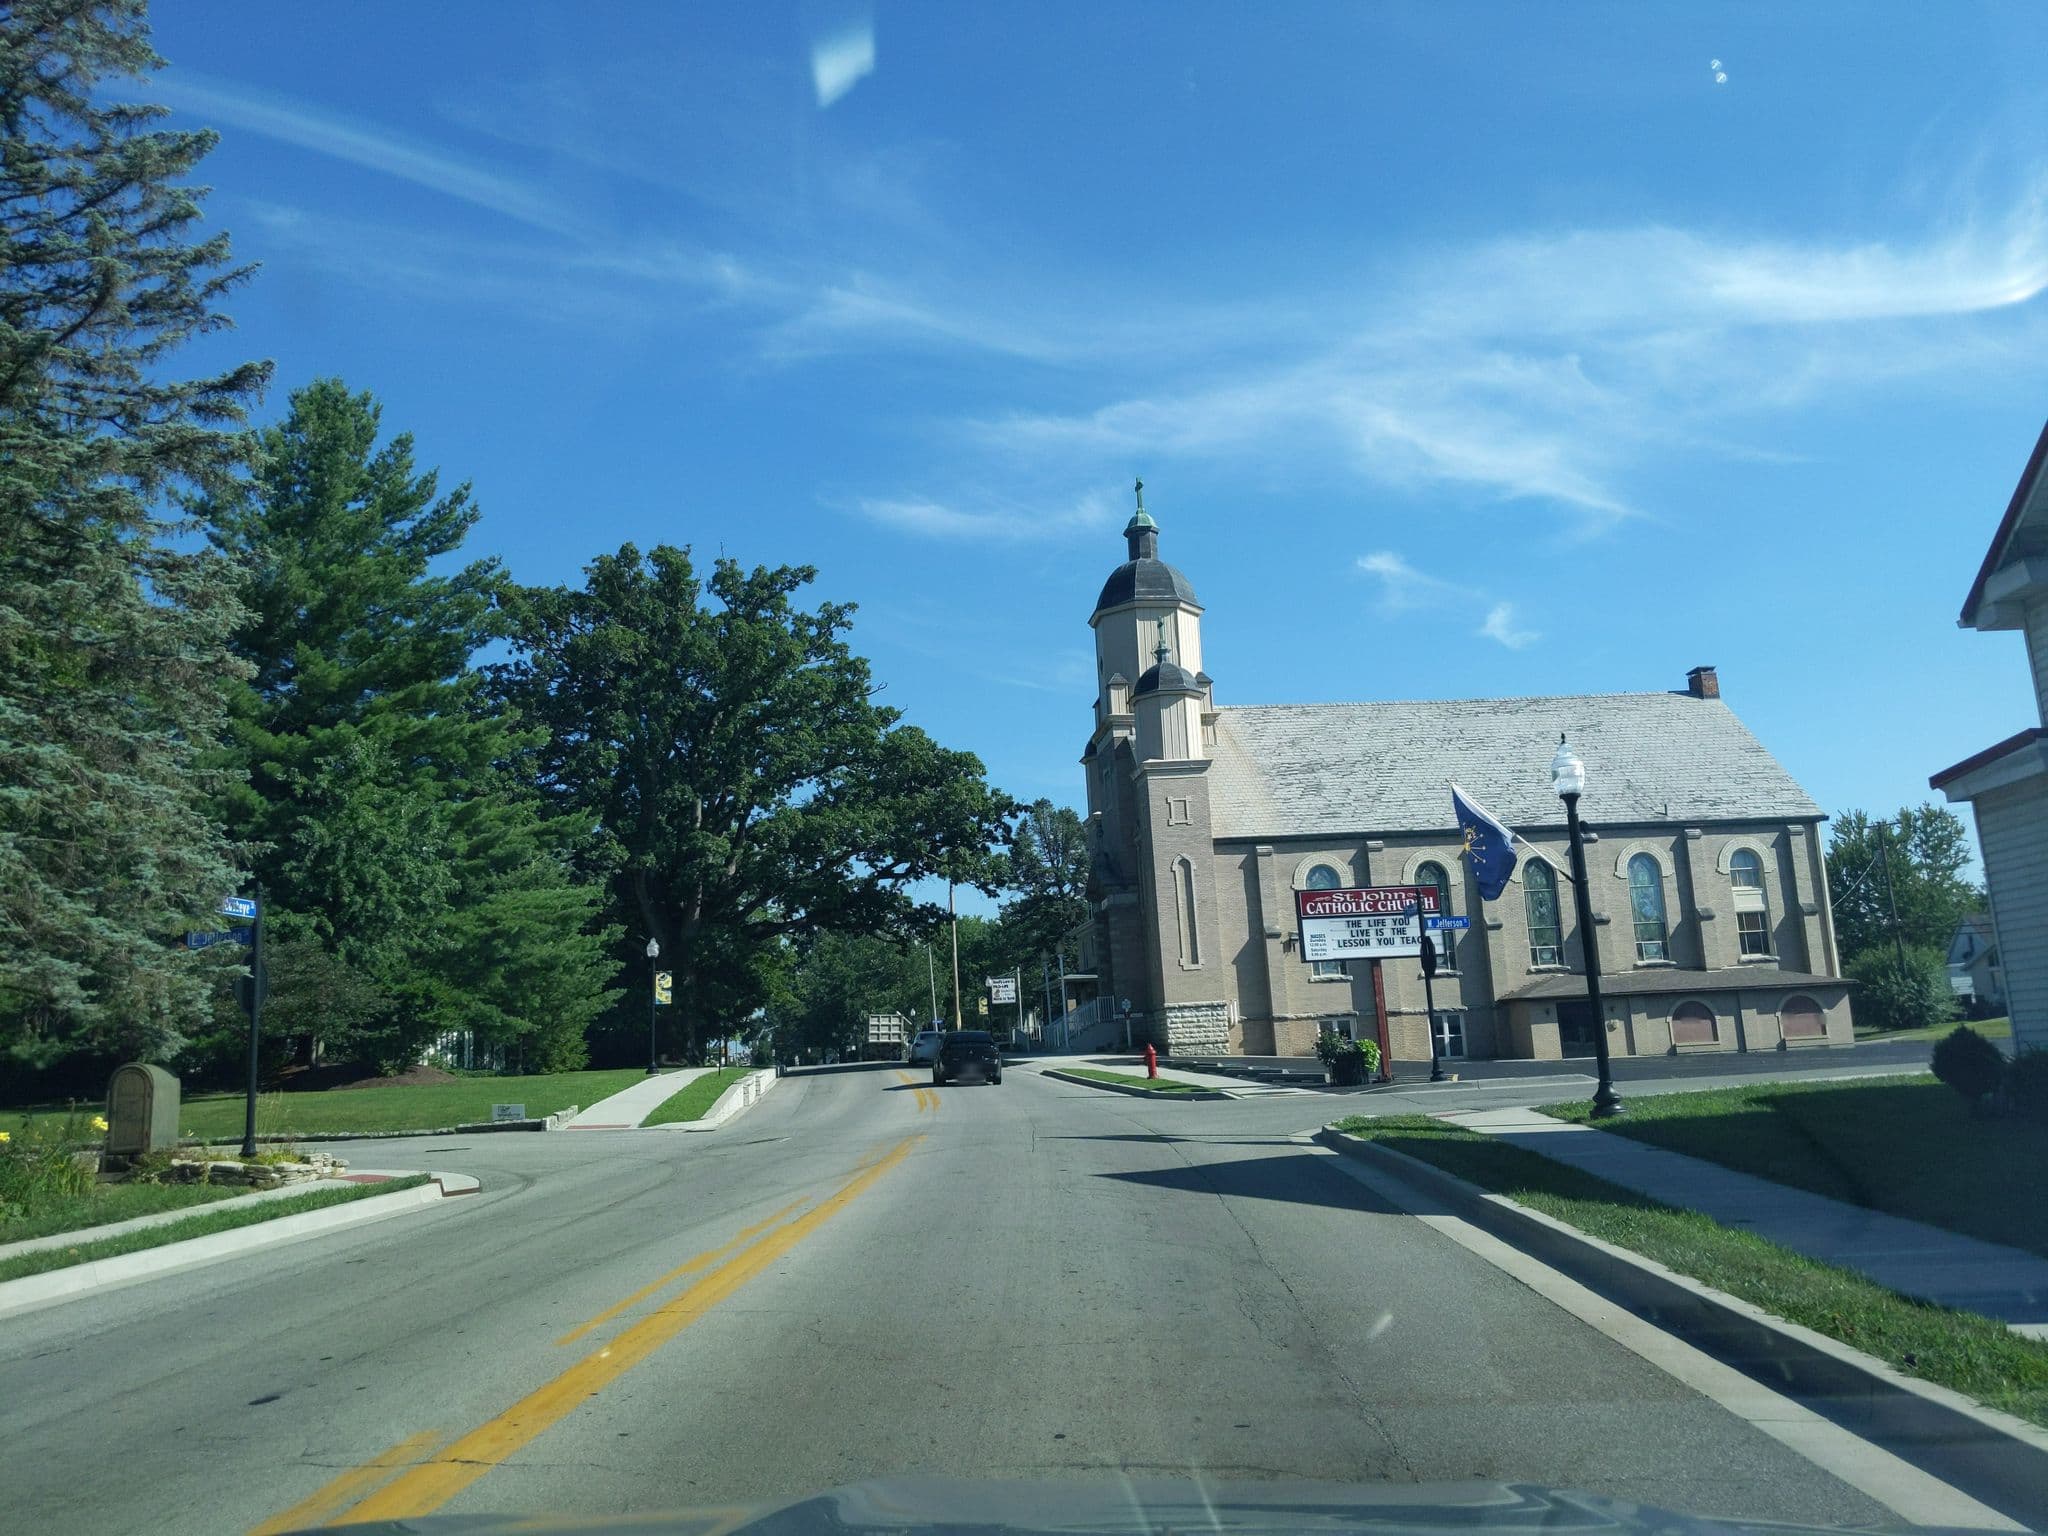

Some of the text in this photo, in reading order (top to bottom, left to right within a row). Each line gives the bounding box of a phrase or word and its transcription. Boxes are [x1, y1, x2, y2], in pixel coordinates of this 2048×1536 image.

[1306, 900, 1374, 915] CATHOLIC
[1377, 896, 1435, 912] CHUH
[1346, 917, 1410, 929] THE LIFE YOU
[1436, 918, 1463, 928] Jefferson
[1350, 926, 1408, 938] LIVE IS THE
[1337, 938, 1371, 948] LESSON
[1376, 937, 1395, 946] YOU
[1400, 936, 1423, 945] TEAC
